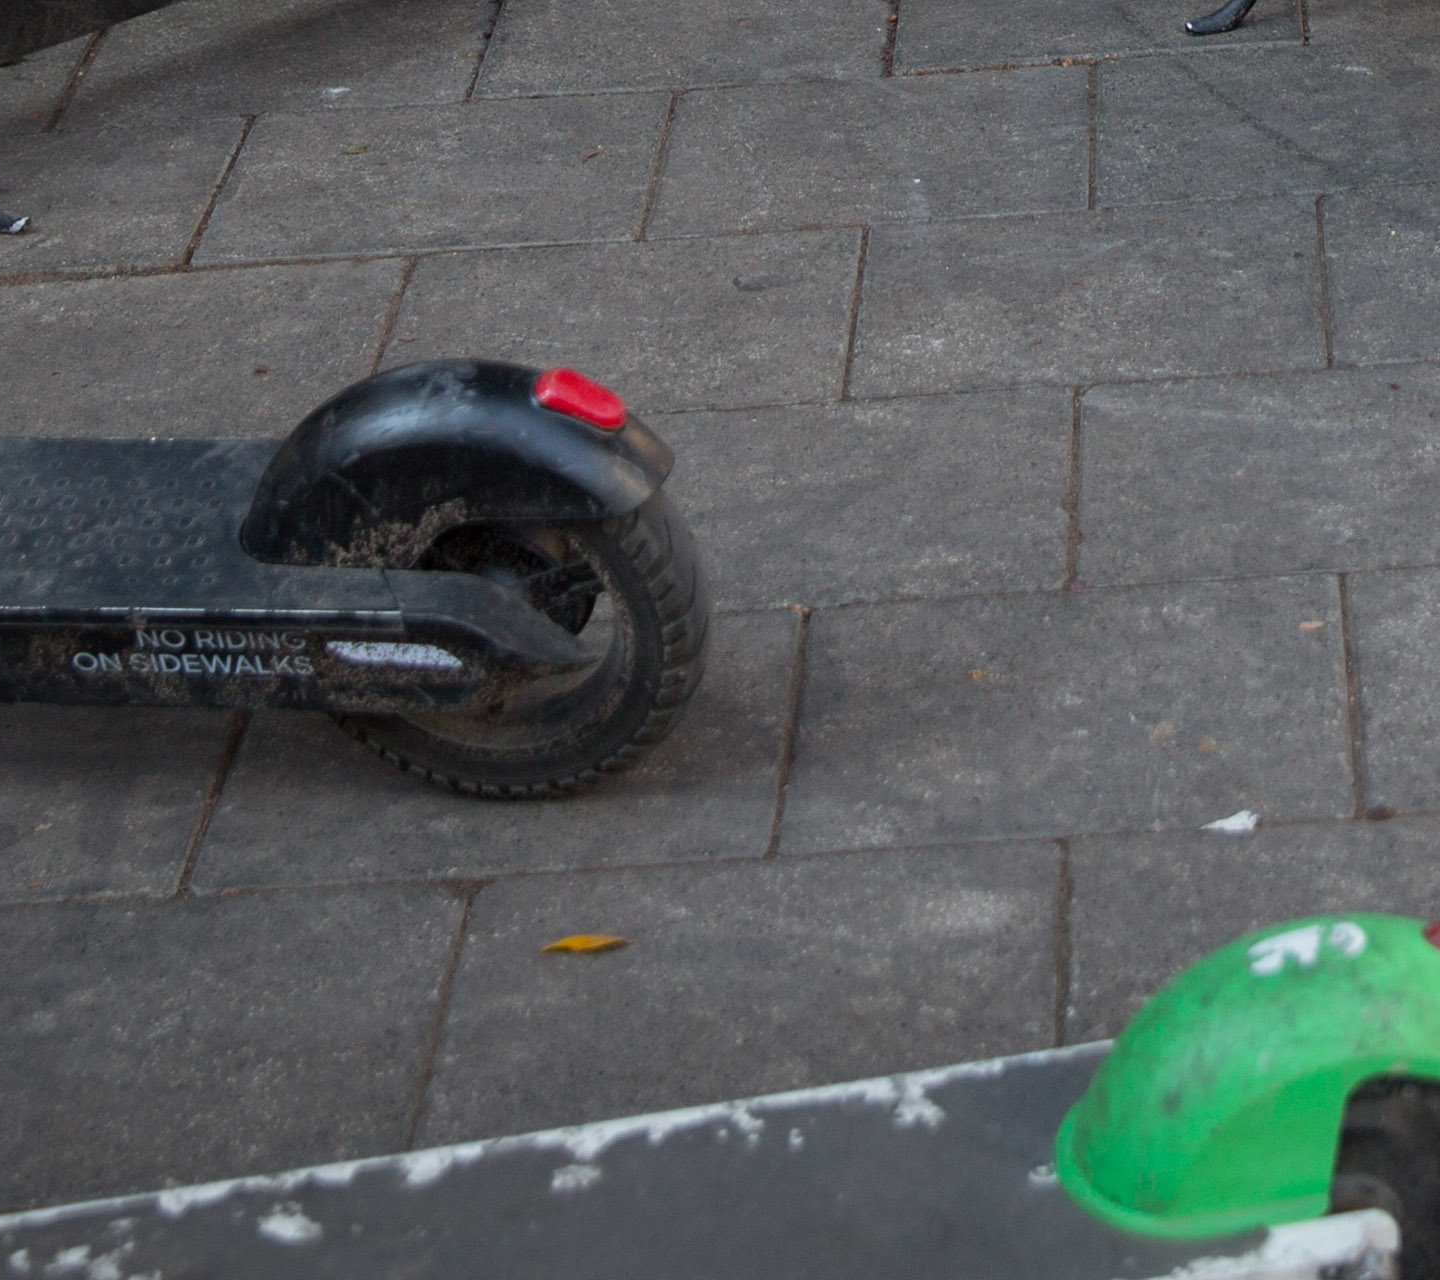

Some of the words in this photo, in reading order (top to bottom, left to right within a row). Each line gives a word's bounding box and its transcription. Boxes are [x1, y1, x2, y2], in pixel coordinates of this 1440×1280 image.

[136, 629, 186, 648] NO
[195, 629, 307, 650] RIDING
[73, 652, 123, 672] ON
[129, 653, 314, 675] SIDEWALKS
